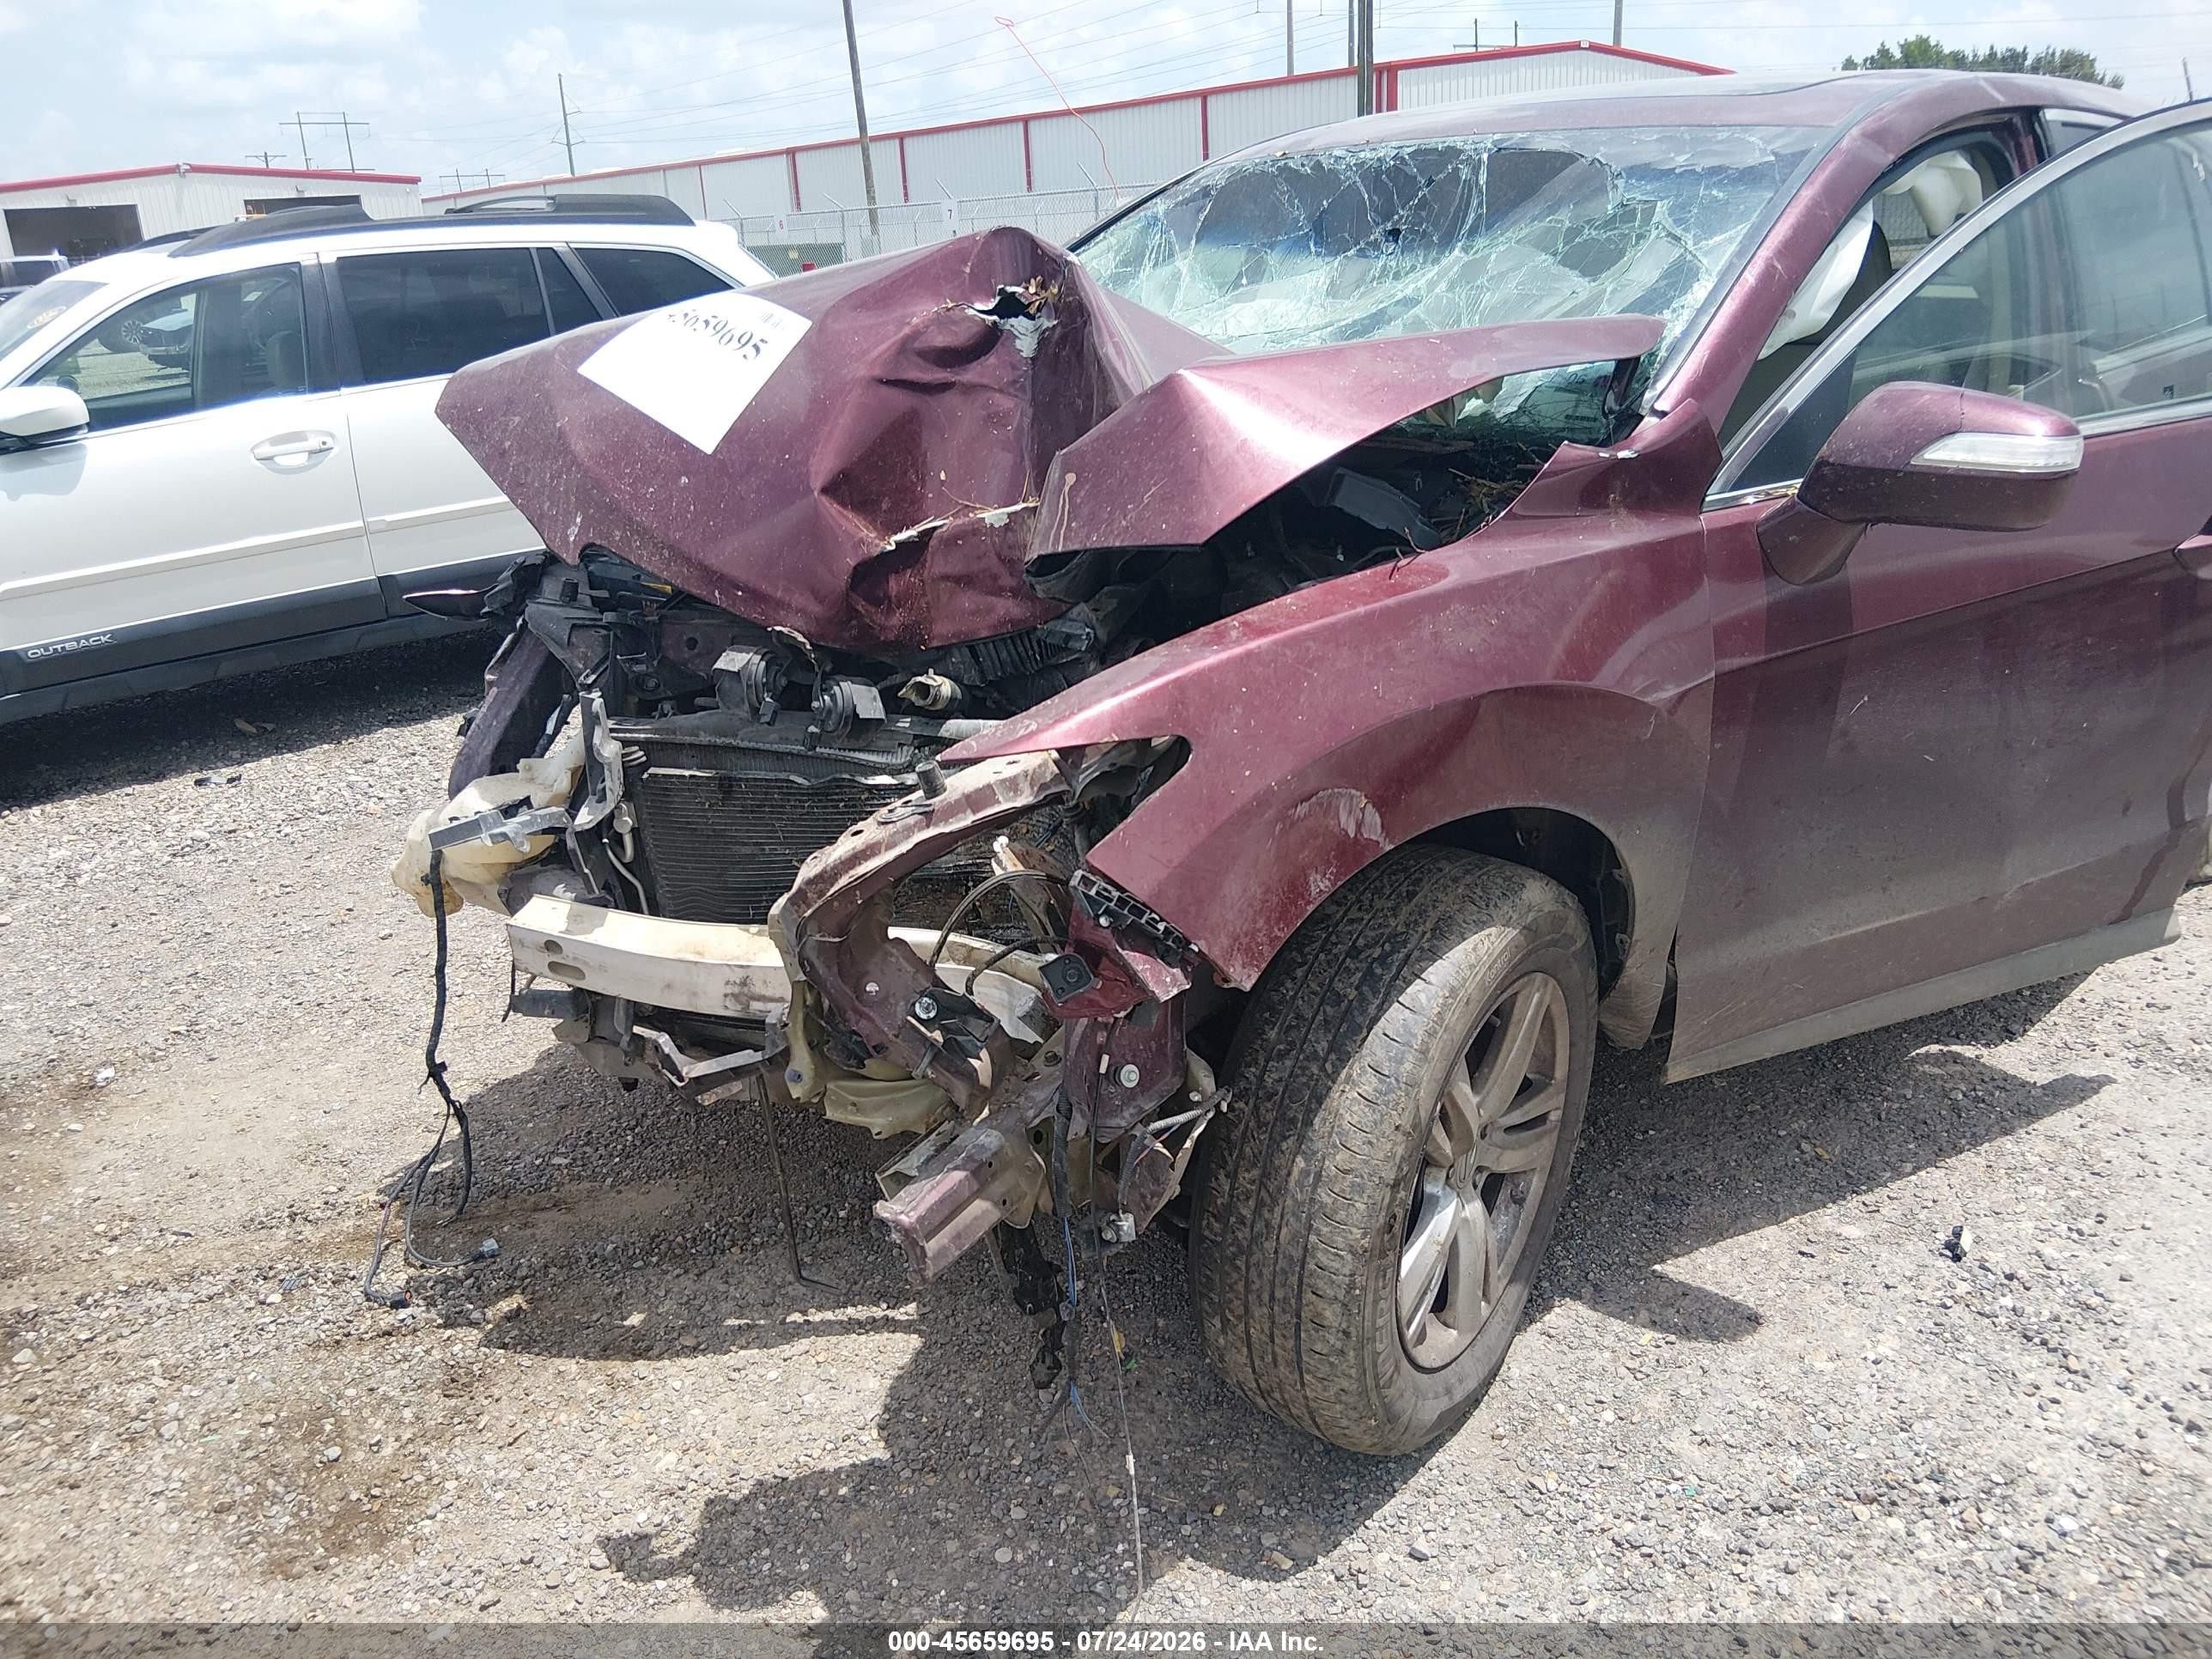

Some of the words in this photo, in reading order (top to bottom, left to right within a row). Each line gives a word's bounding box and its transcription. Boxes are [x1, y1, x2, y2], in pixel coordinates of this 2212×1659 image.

[947, 209, 952, 220] 7
[779, 219, 784, 230] 6
[27, 634, 112, 659] OUTBACK
